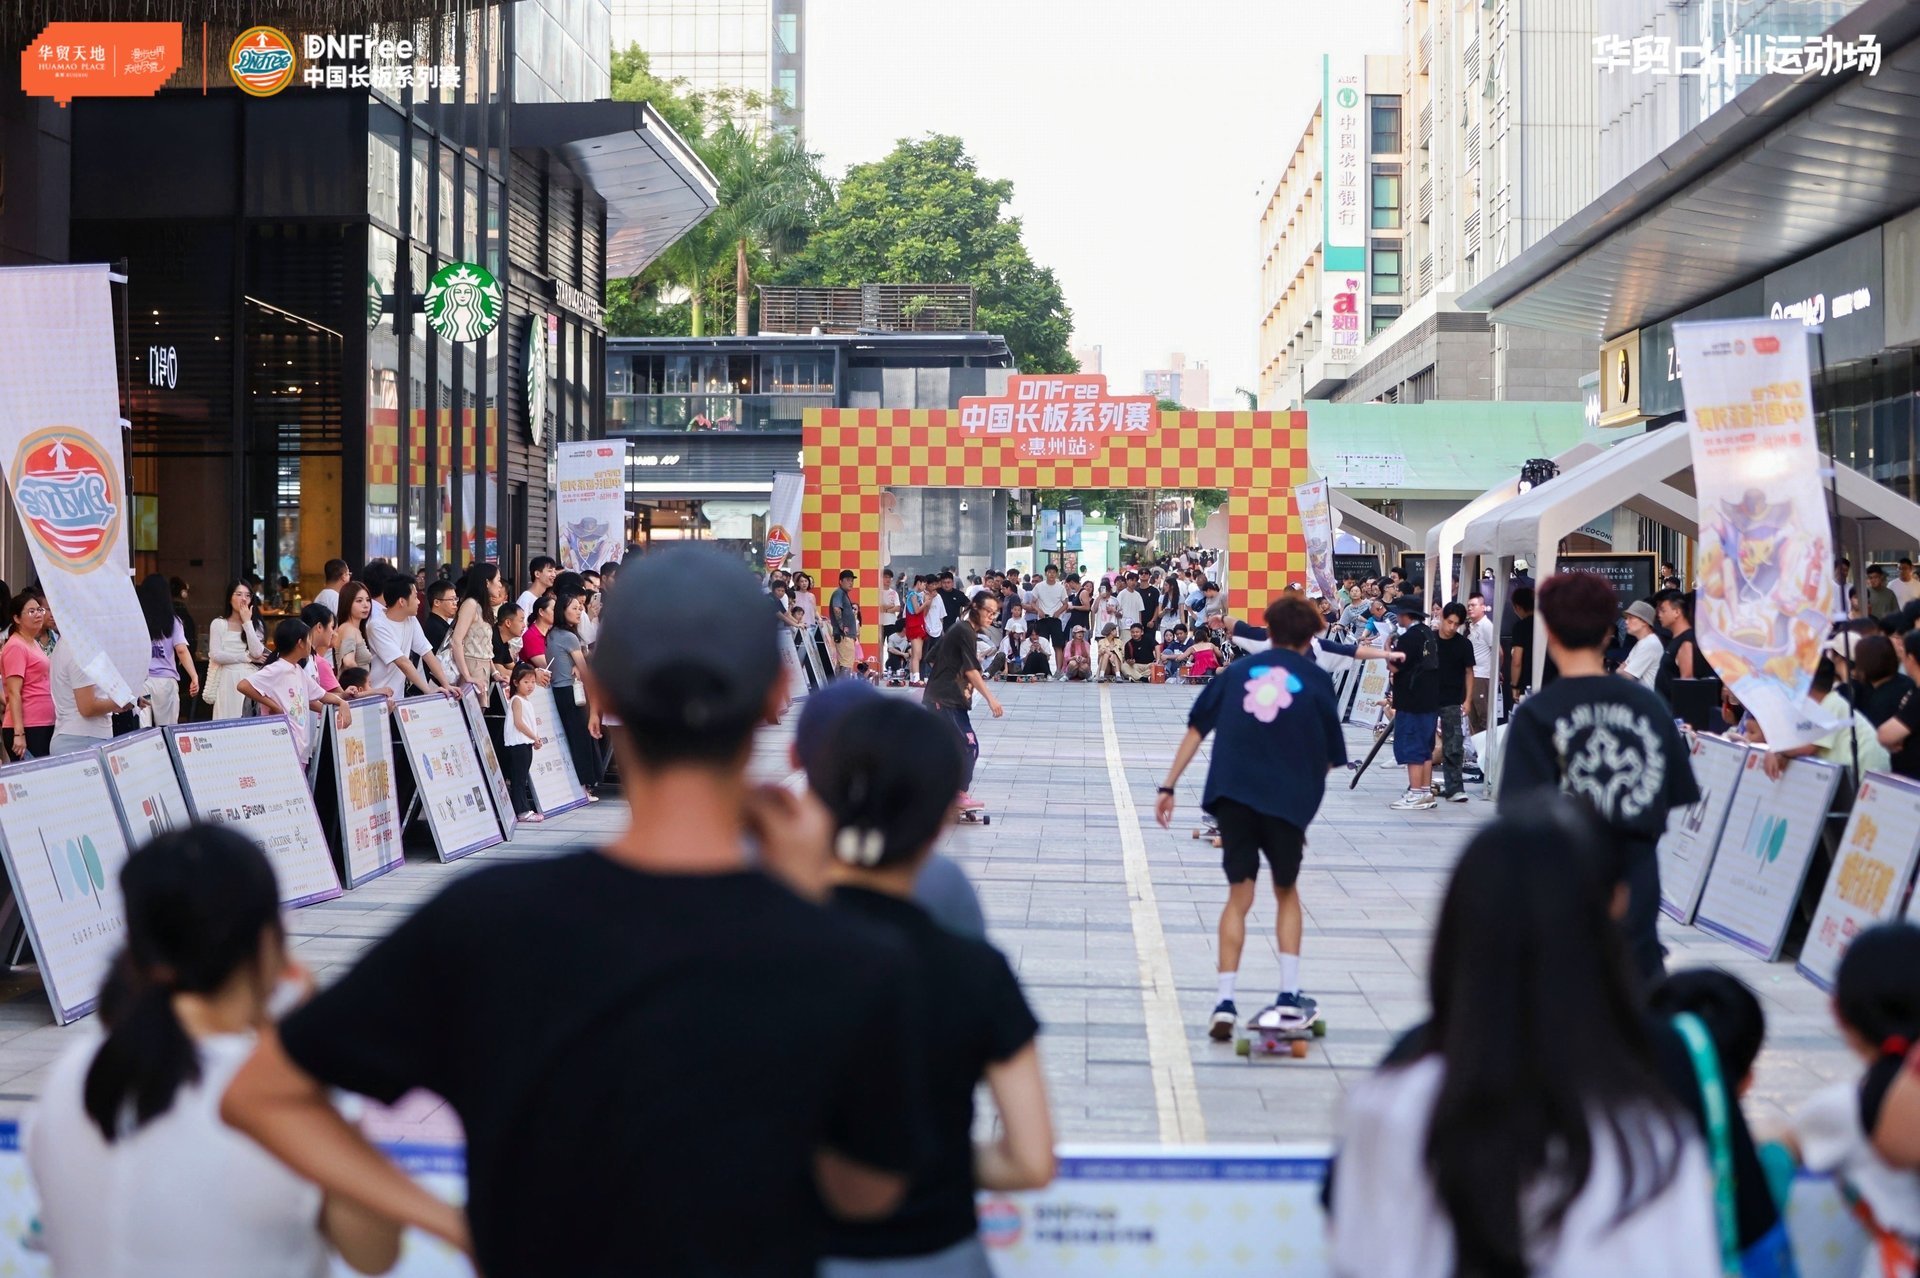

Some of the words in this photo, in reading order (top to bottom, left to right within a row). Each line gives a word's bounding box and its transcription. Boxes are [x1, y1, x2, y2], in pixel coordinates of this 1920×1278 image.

[1338, 114, 1357, 226] 中国农业银行
[1018, 380, 1099, 400] DNFree
[961, 402, 1151, 433] 中国长板系列赛
[226, 808, 241, 821] FILA
[72, 926, 97, 945] SURF
